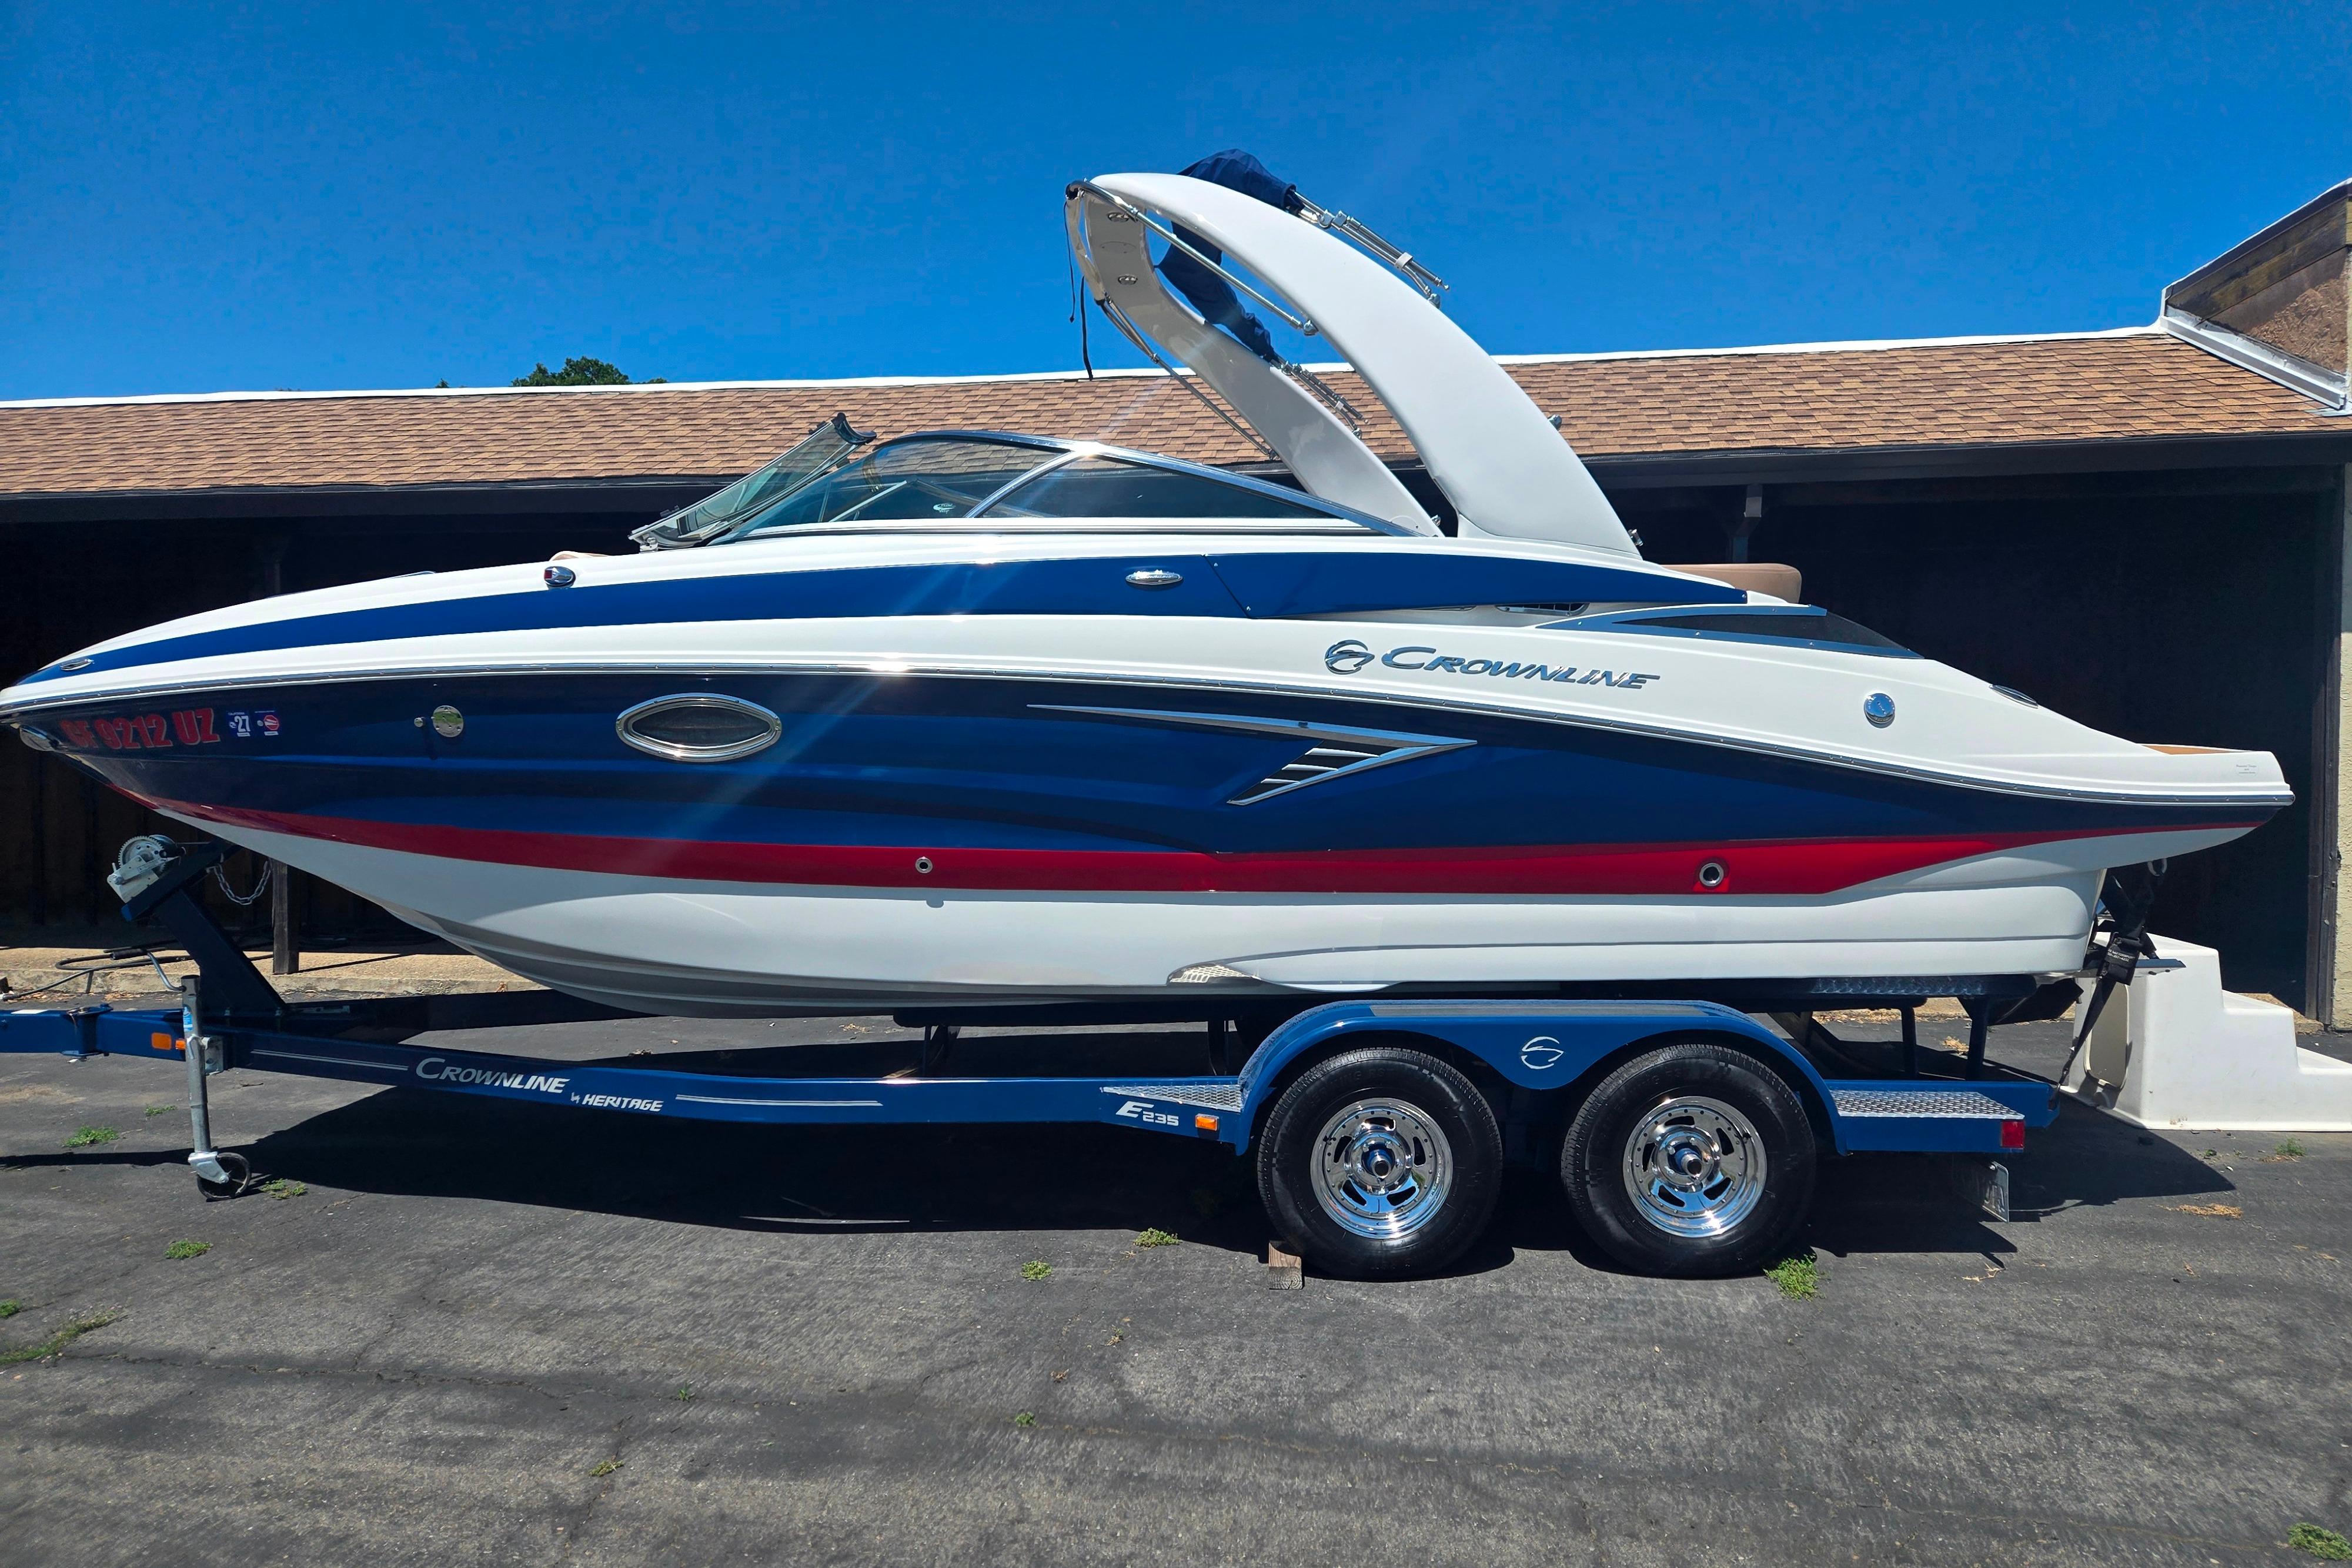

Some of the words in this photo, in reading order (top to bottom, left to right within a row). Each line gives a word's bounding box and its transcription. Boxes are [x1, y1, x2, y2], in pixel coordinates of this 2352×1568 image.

[1381, 646, 1661, 689] CROWNLINE
[94, 713, 174, 750] 9212
[172, 707, 221, 745] UZ
[234, 715, 251, 733] 27
[416, 1058, 570, 1094] CROWNLINE
[582, 1094, 664, 1112] HERITAGE
